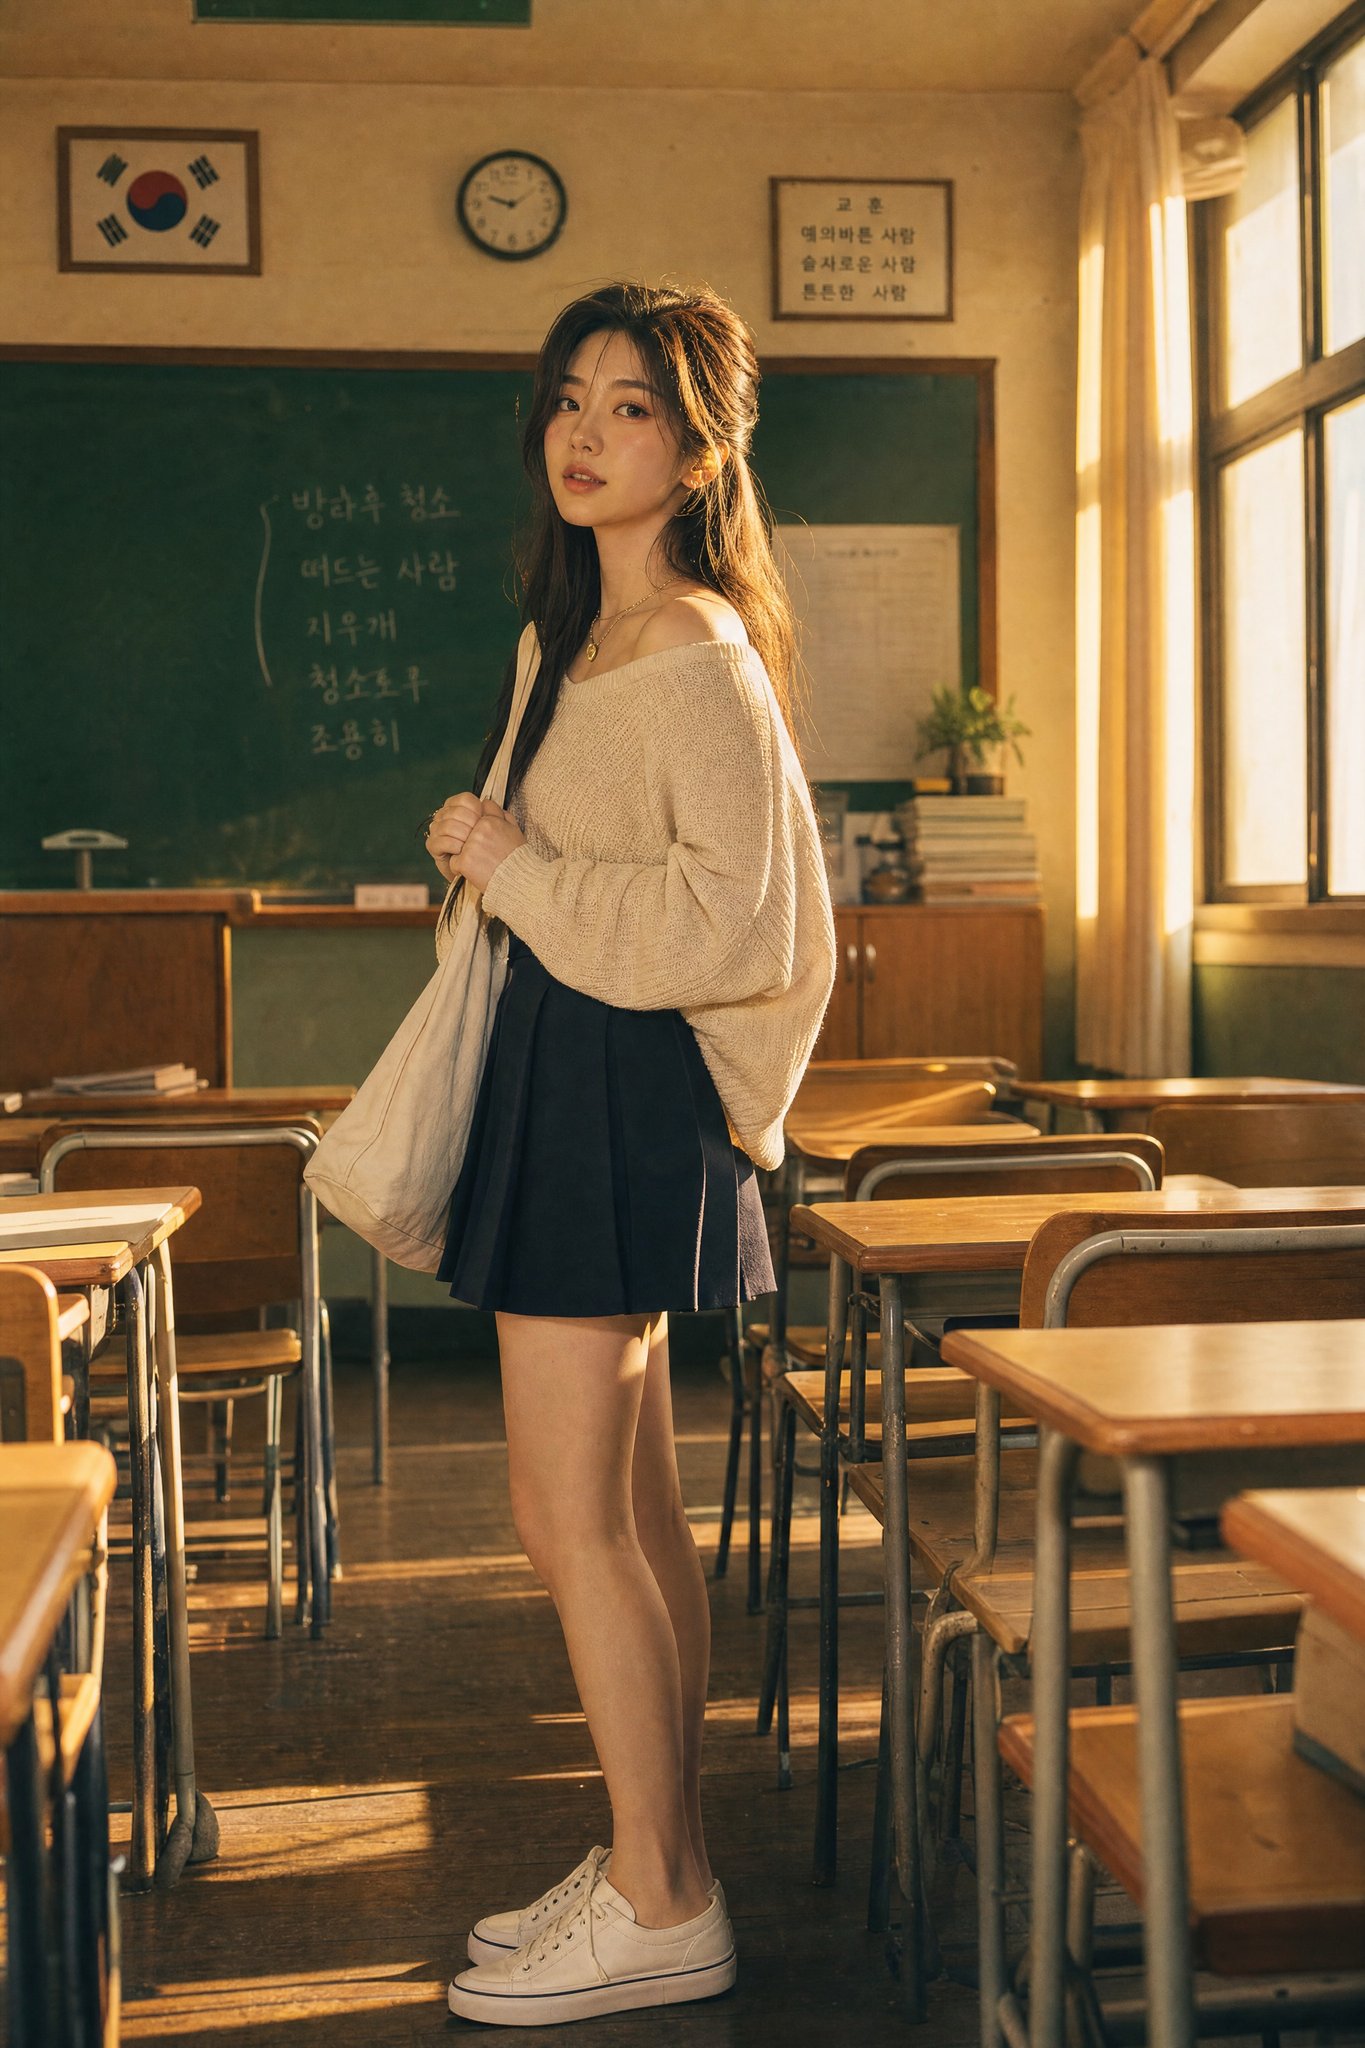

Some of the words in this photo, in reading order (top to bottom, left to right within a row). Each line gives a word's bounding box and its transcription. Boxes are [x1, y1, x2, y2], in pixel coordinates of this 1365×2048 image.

[882, 254, 916, 274] 사람
[872, 283, 907, 302] 사람
[397, 548, 461, 592] 사람
[305, 608, 399, 647] 지우개
